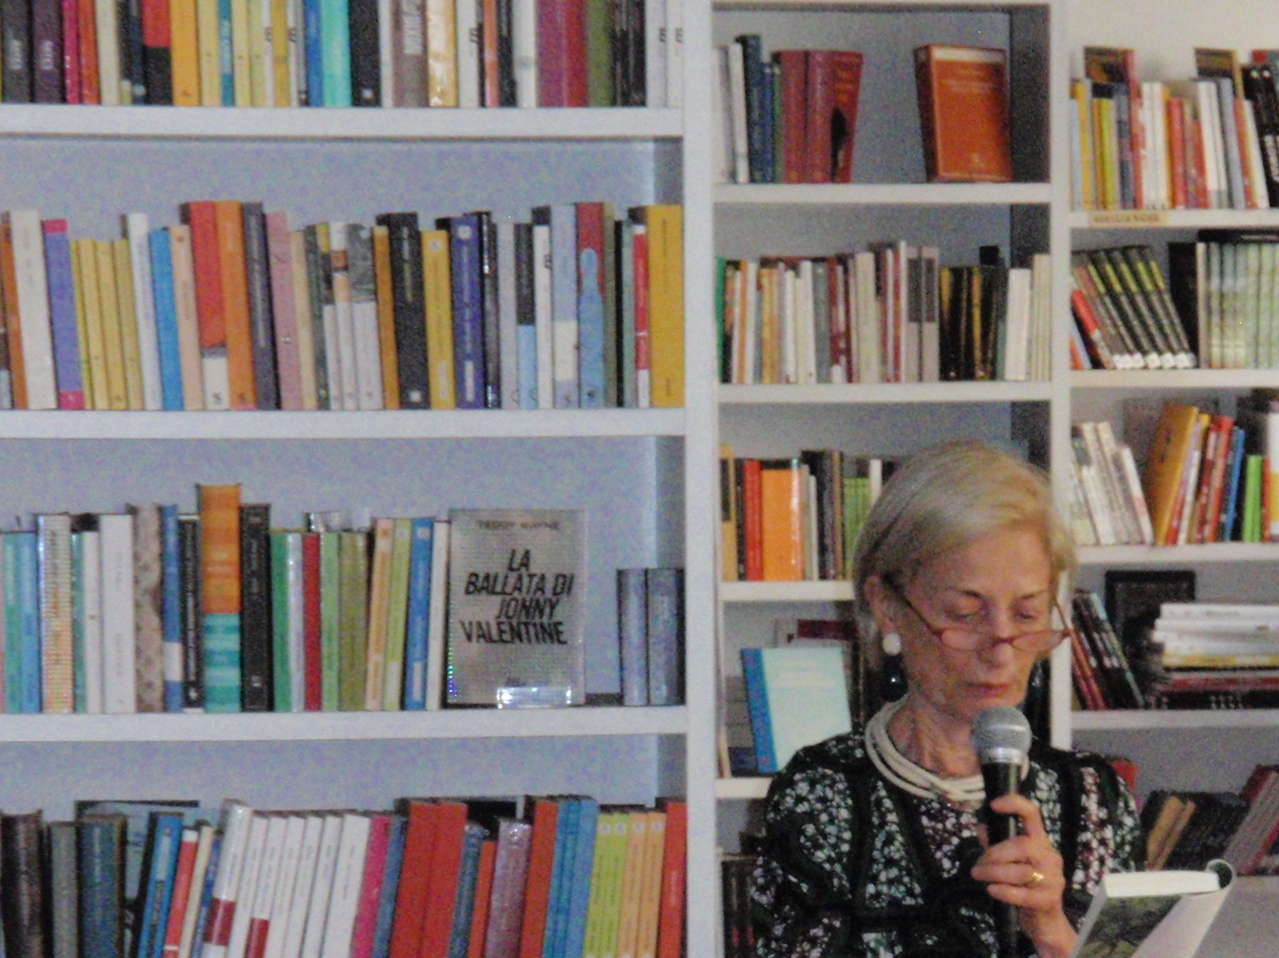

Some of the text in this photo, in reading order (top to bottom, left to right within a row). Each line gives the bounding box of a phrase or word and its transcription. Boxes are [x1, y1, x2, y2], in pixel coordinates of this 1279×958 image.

[508, 549, 531, 572] LA
[464, 572, 575, 597] BALLATA DI
[496, 597, 561, 620] JONNY
[460, 620, 568, 645] VALENTINE
